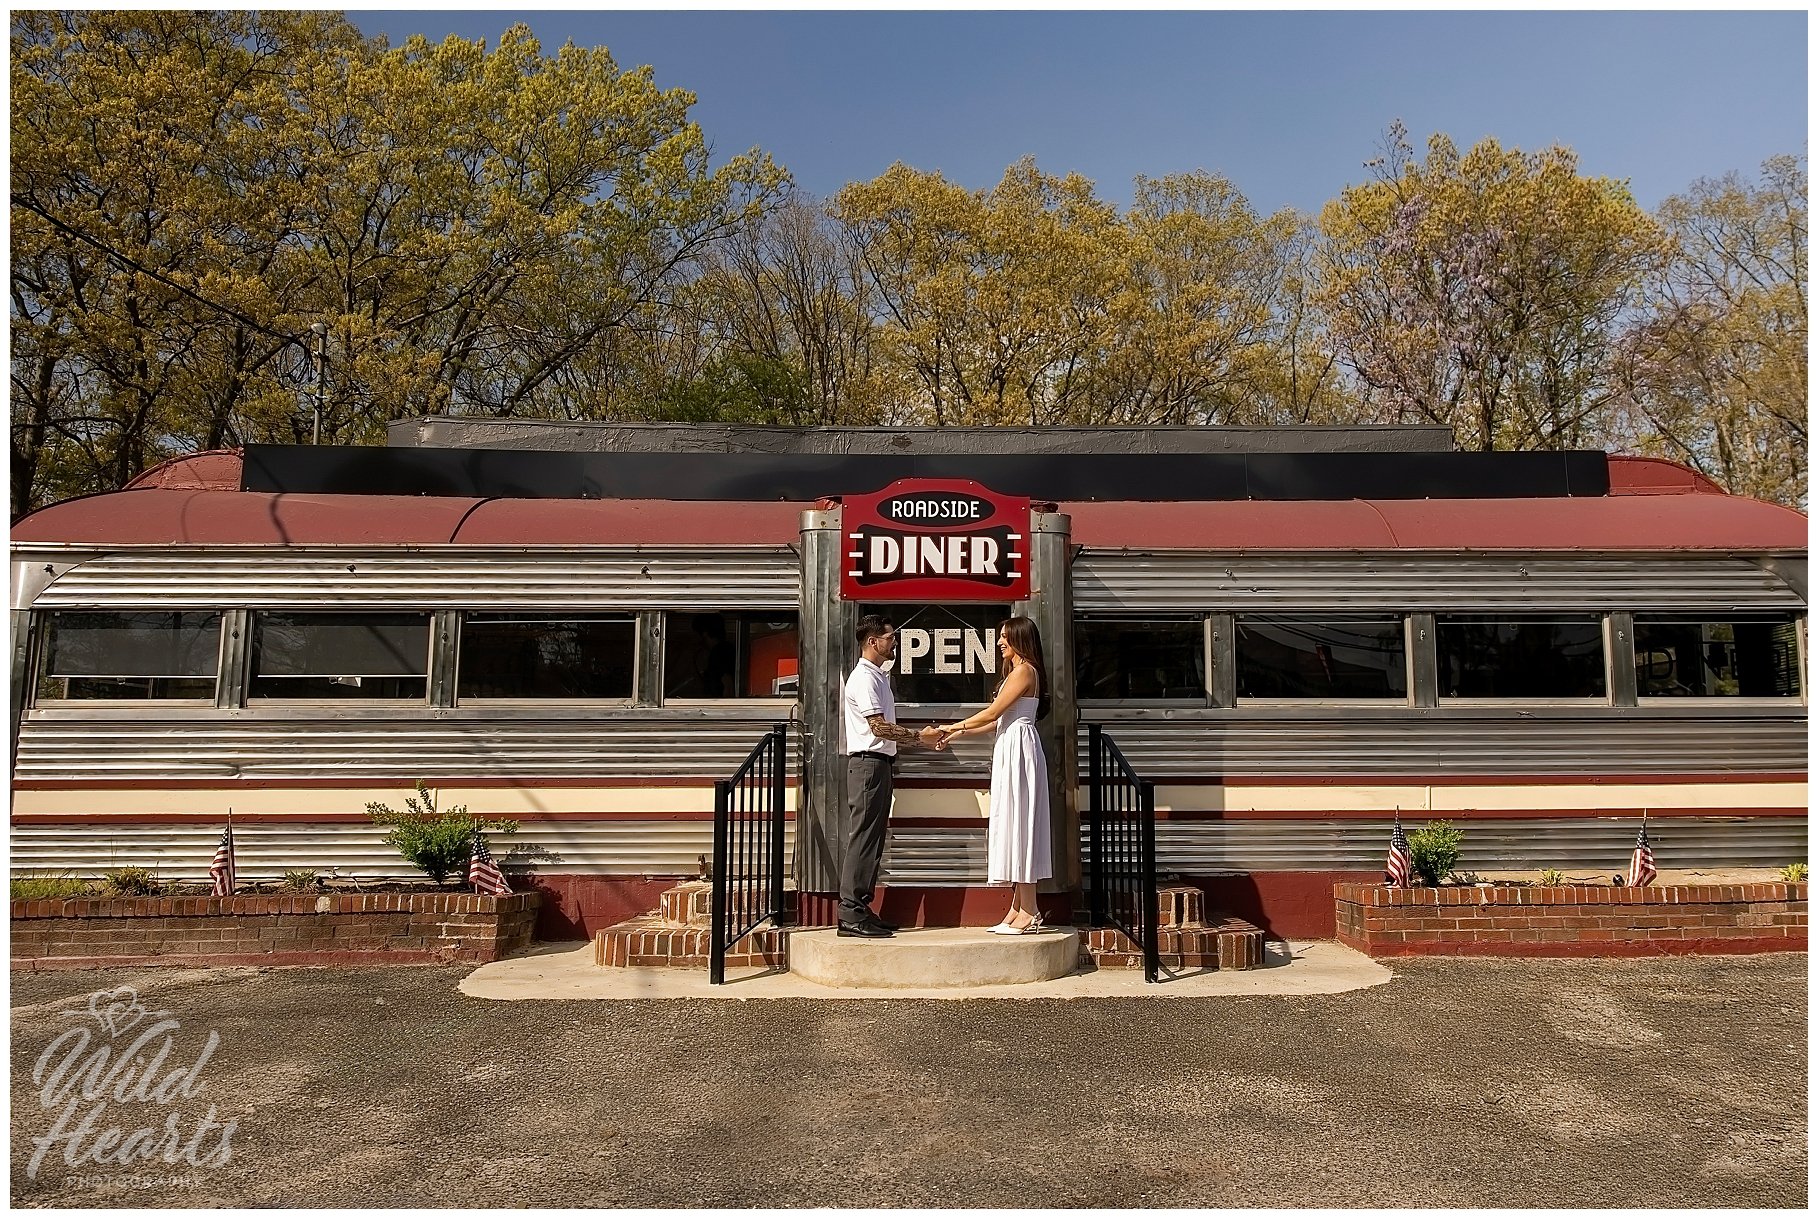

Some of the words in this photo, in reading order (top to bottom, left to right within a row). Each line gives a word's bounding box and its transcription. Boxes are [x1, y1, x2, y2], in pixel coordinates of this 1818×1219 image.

[891, 500, 980, 518] ROADSIDE
[869, 535, 1000, 575] DINER
[881, 628, 996, 675] PEN
